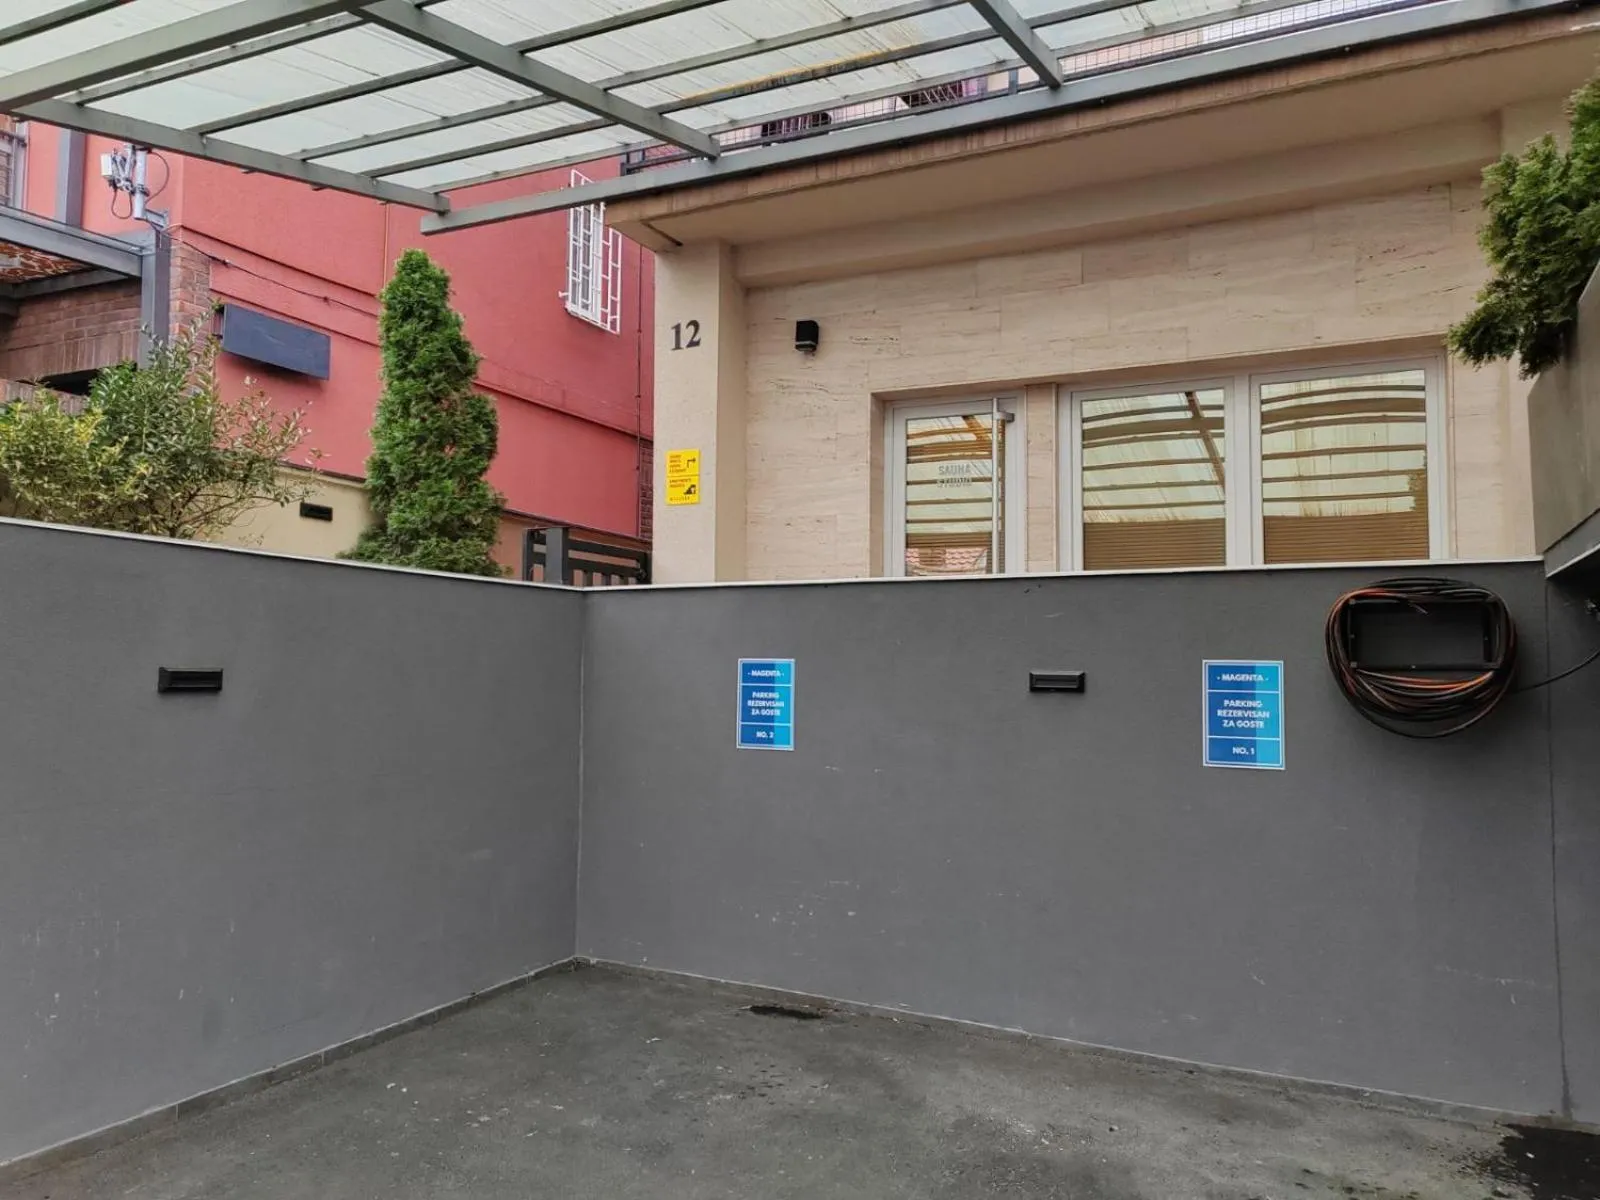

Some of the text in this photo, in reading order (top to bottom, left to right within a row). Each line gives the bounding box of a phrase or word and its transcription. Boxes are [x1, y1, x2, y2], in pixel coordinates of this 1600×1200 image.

[671, 319, 701, 350] 12
[751, 669, 781, 677] MAGENTA
[1221, 673, 1265, 682] MAGENTA
[752, 691, 780, 699] PARKING
[747, 700, 785, 708] REZERVISAN
[1223, 699, 1263, 707] PARKING
[1217, 709, 1271, 719] REZERVISAN
[1222, 720, 1265, 729] ZA GOSTE
[1232, 746, 1255, 755] NO. 1
